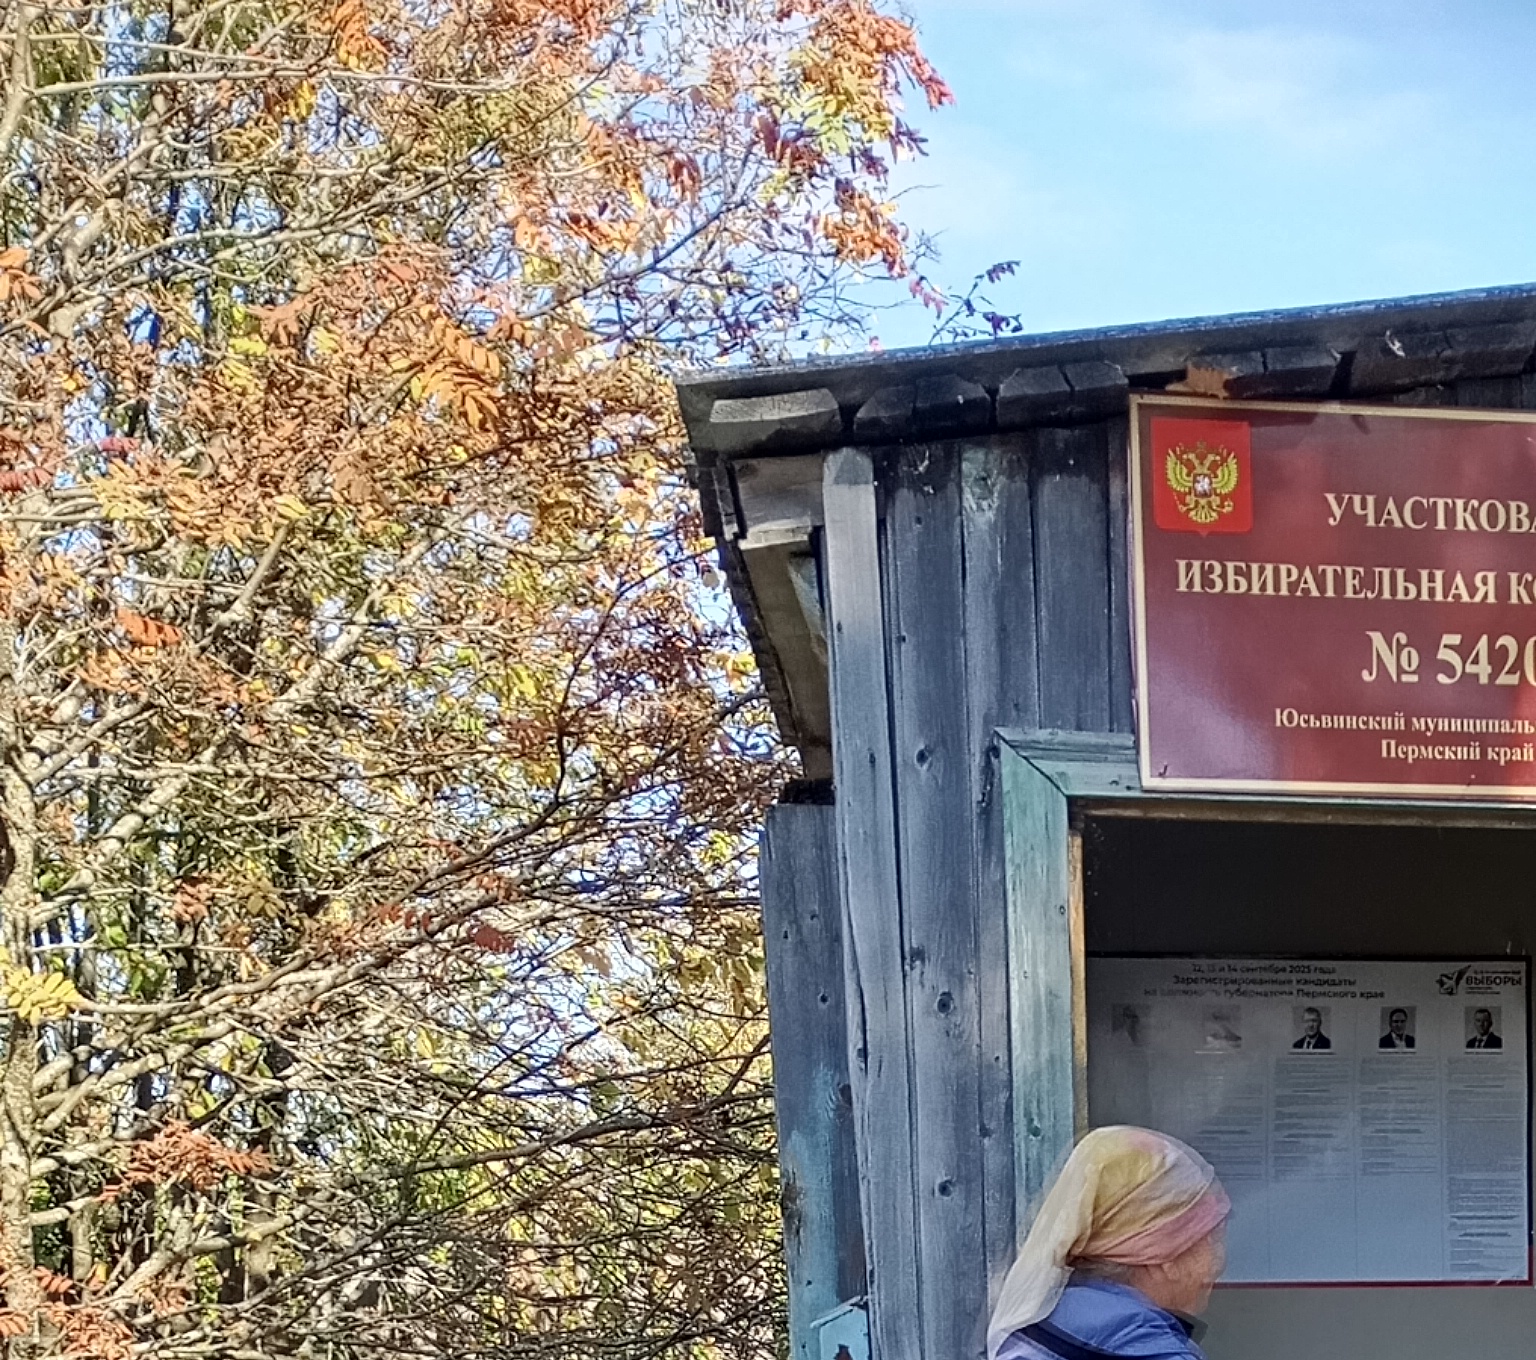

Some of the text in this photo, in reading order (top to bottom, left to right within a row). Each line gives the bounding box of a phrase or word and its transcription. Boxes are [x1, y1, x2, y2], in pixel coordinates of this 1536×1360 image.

[1175, 558, 1498, 604] ИЗБИРАТЕЛЬНАЯ
[1361, 630, 1420, 683] №
[1274, 707, 1406, 732] Юсьвинский
[1380, 739, 1535, 765] Пермский край
[1465, 976, 1522, 986] ВЫБОРЫ
